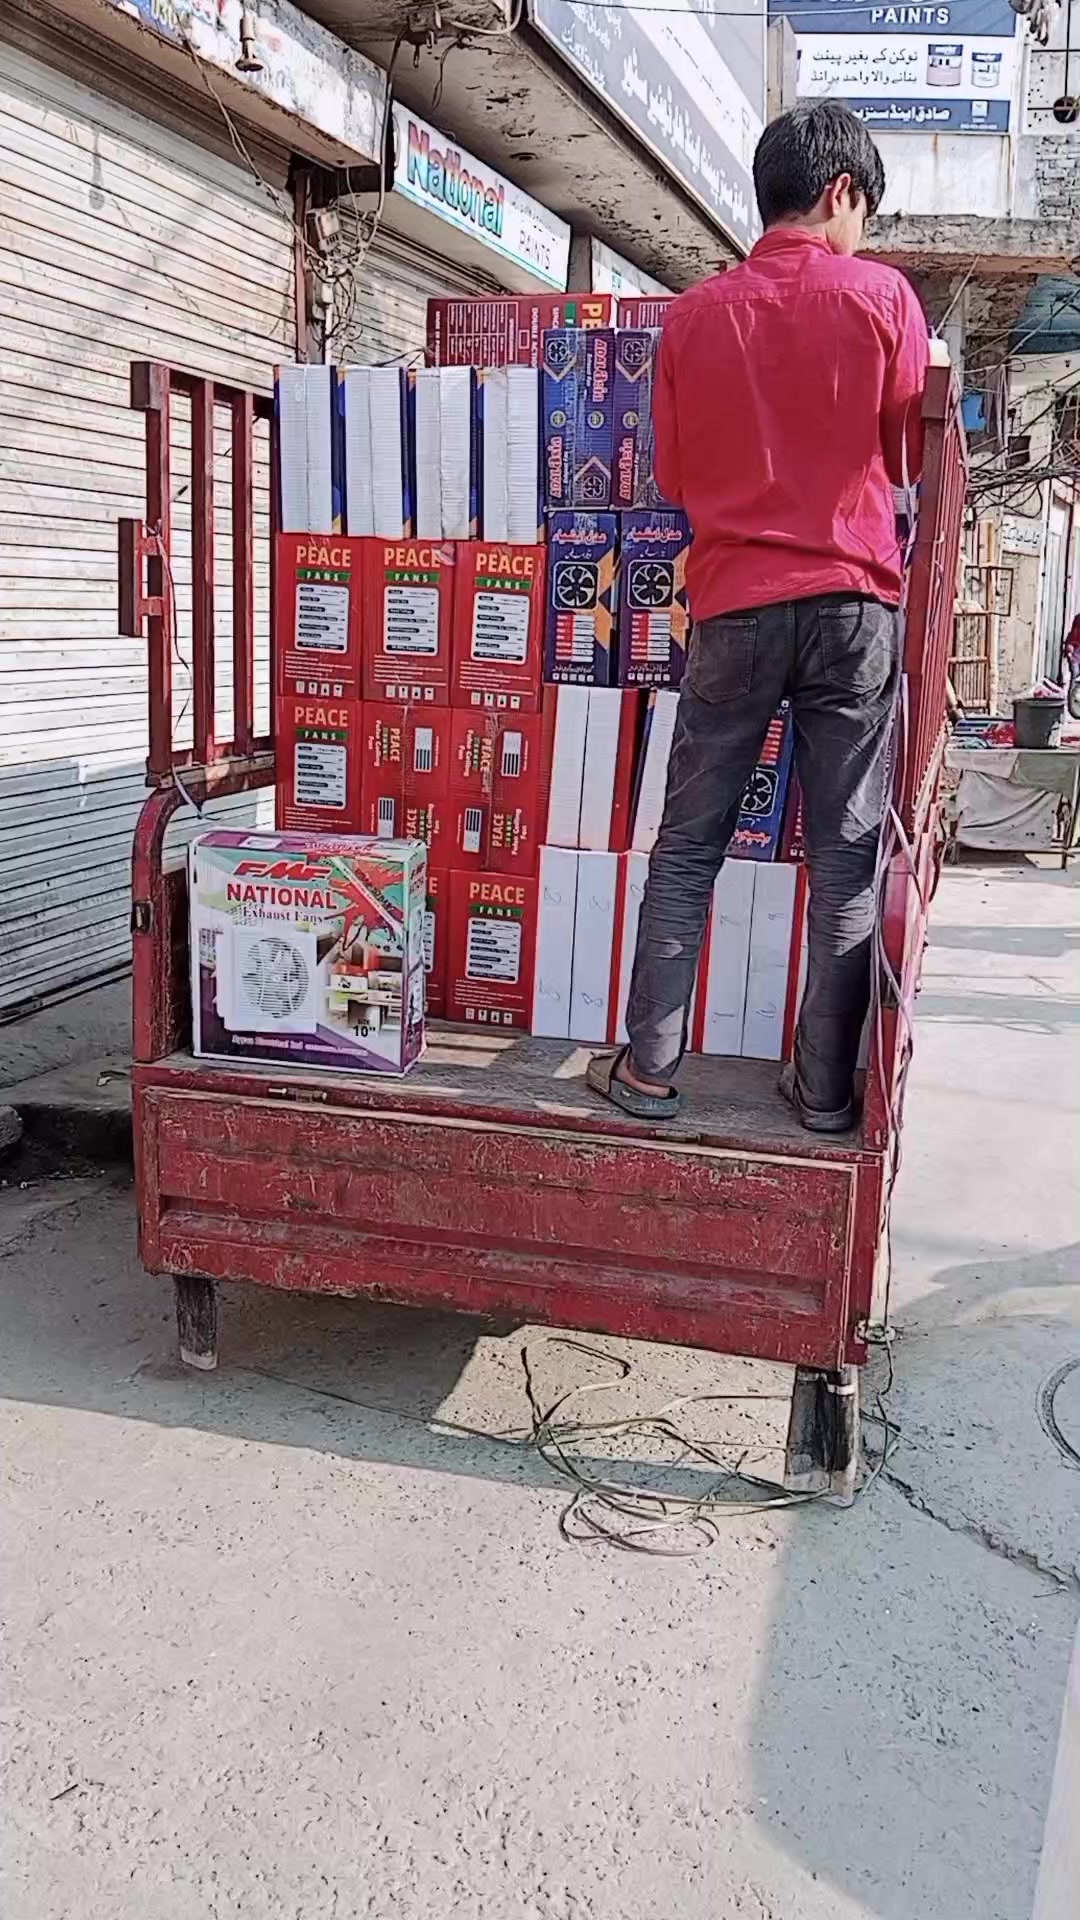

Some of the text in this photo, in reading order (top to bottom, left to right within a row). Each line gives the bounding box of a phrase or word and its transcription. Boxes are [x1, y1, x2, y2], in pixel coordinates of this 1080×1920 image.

[871, 8, 950, 25] PAINTS
[407, 120, 505, 239] National
[296, 545, 351, 567] PEACE
[384, 547, 441, 568] PEACE
[475, 552, 533, 576] PEACE
[306, 571, 340, 582] FANS
[394, 573, 429, 583] FANS
[486, 579, 520, 590] FANS
[294, 706, 349, 727] PEACE
[305, 730, 337, 740] FANS
[390, 728, 400, 762] PEACE
[406, 808, 417, 840] PEACE
[492, 813, 504, 847] PEACE
[232, 858, 333, 882] FMF
[227, 883, 337, 909] NATIONAL
[469, 881, 525, 904] PEACE
[243, 906, 324, 925] Exhaust Fans
[479, 905, 512, 917] FANS
[353, 1025, 376, 1038] 10"
